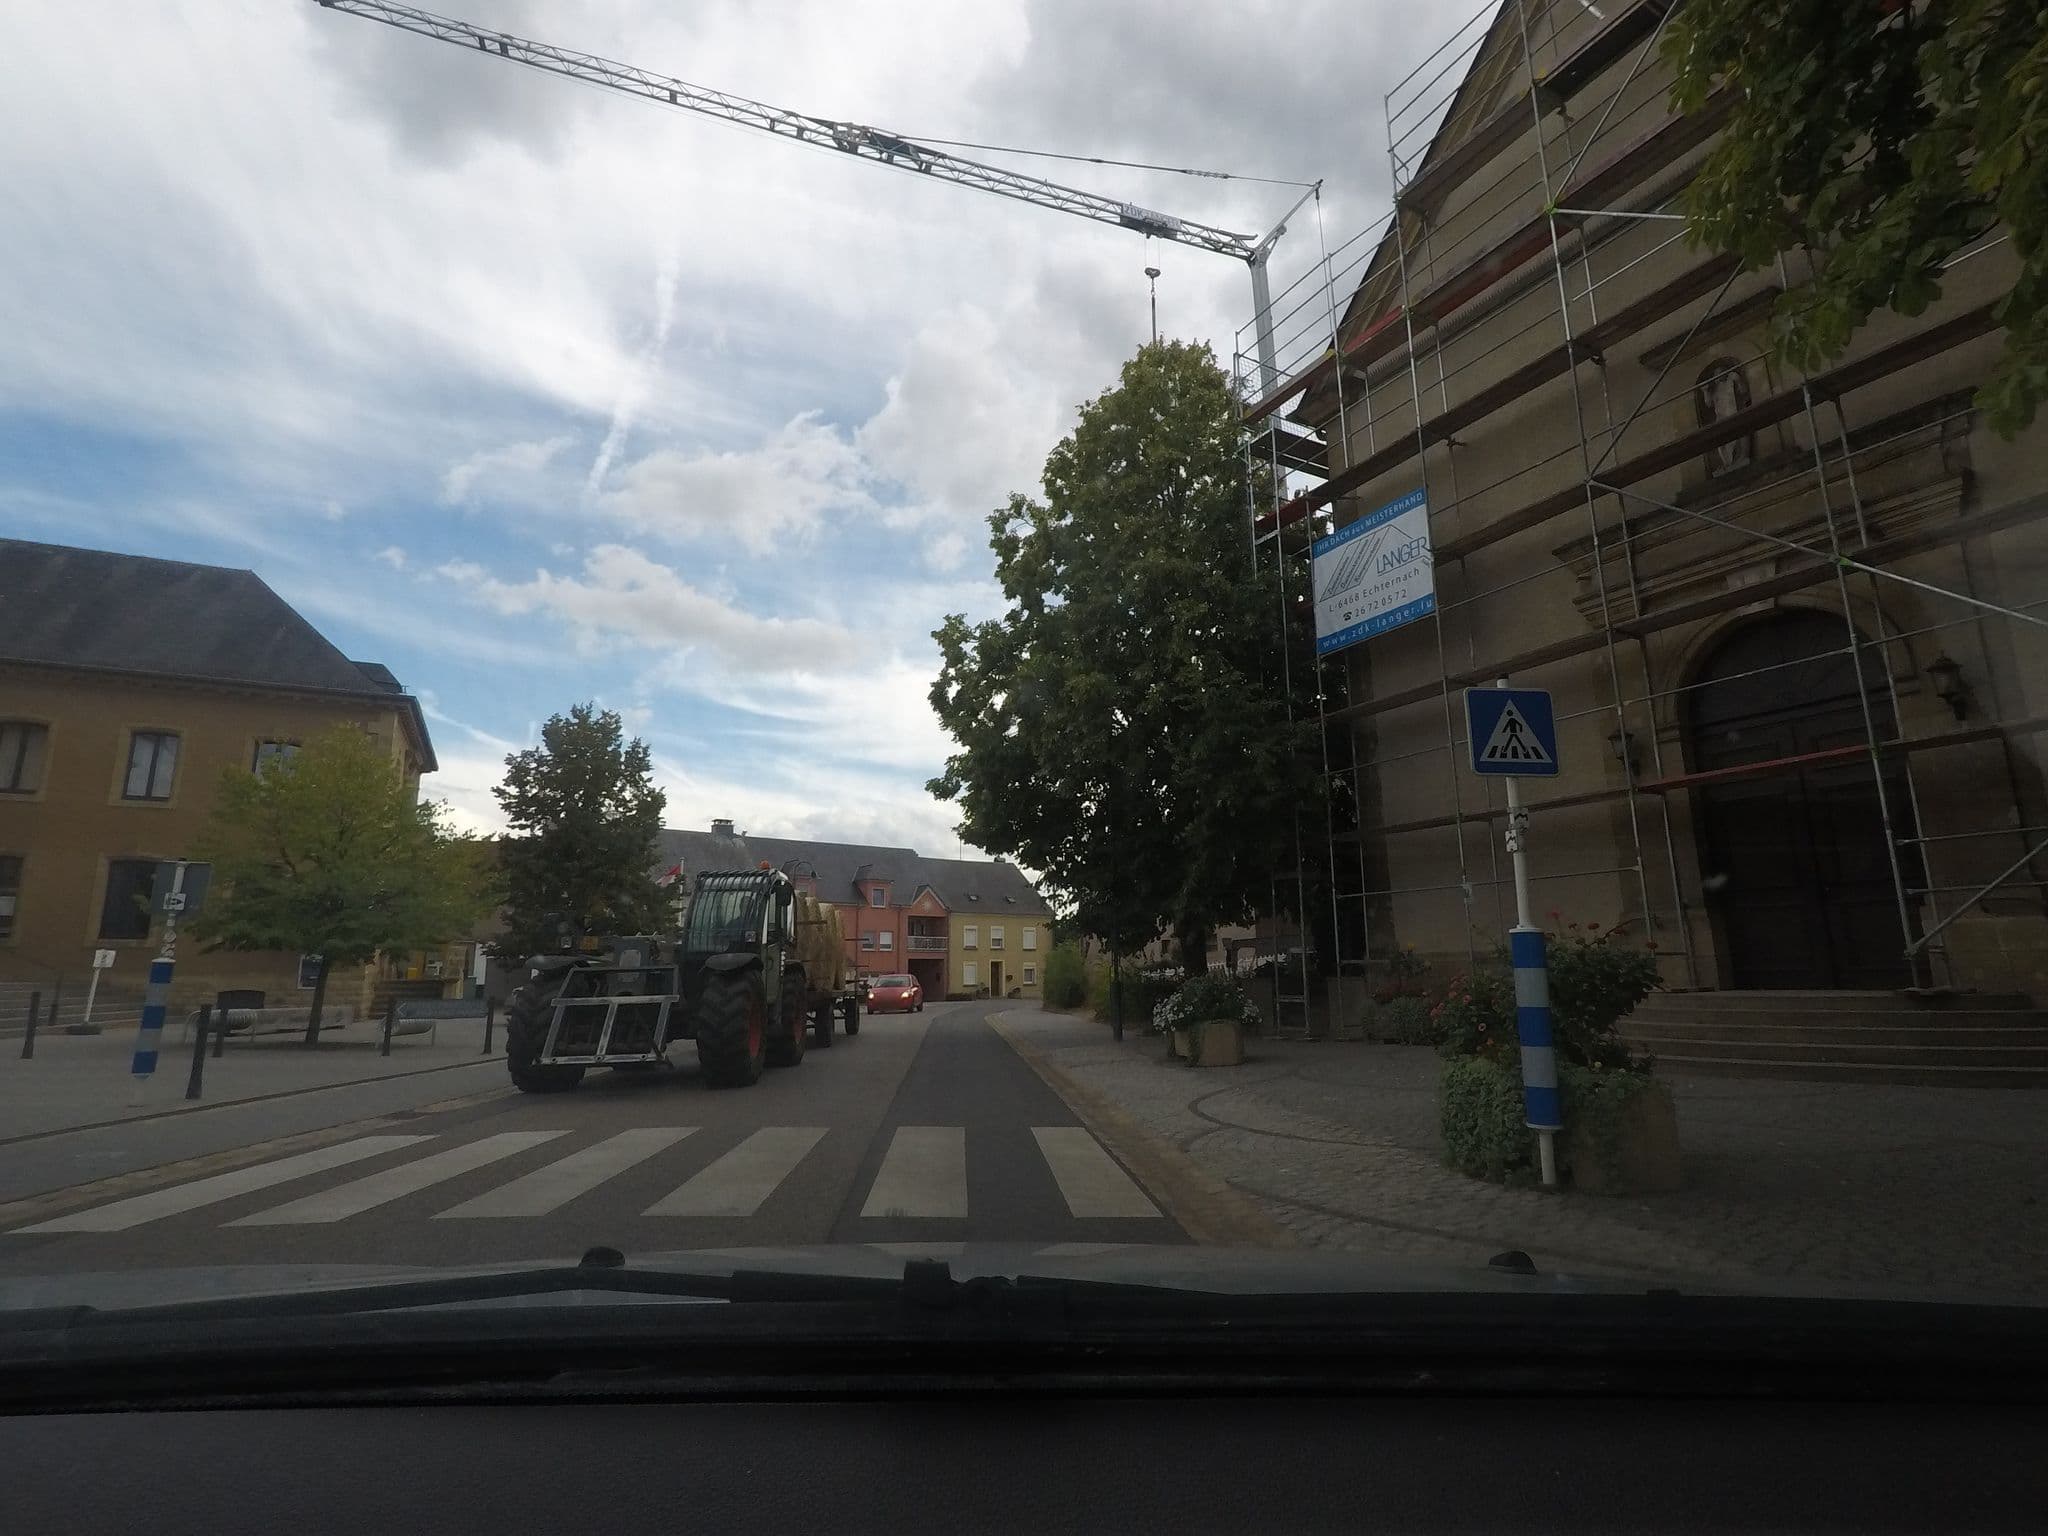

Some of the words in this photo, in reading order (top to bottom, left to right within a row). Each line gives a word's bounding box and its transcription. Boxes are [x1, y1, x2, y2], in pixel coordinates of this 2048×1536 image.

[1330, 529, 1350, 546] DACH
[1364, 492, 1424, 528] MEISTERHAND
[1376, 536, 1431, 574] LANGER
[1363, 569, 1420, 598] Echternach
[1322, 600, 1433, 648] www.zdk-langer.lu
